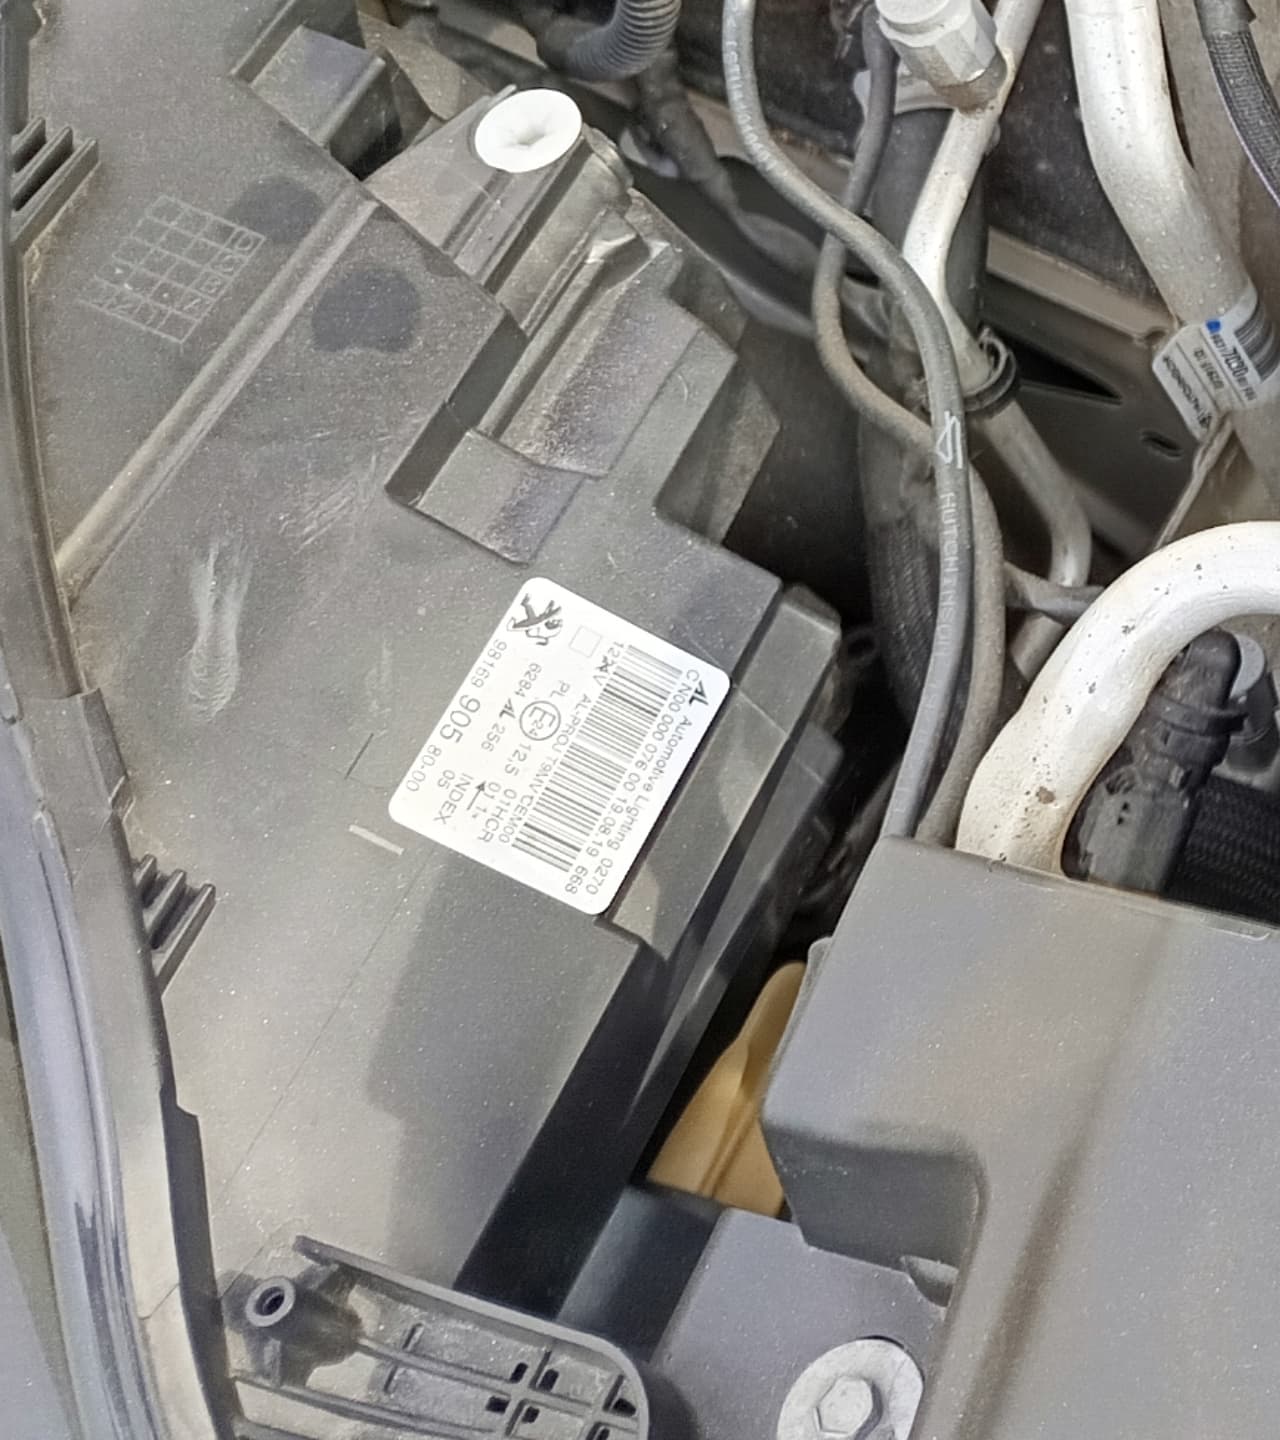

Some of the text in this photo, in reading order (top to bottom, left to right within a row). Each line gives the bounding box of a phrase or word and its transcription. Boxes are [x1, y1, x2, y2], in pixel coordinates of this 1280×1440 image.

[513, 660, 542, 699] 6284
[549, 678, 570, 702] PL
[404, 637, 508, 794] 98169 905 80-00
[550, 692, 593, 755] AL-PROJ
[650, 712, 674, 742] 000
[479, 721, 505, 753] 256
[634, 741, 658, 771] 076
[641, 714, 693, 794] Automotive
[433, 770, 474, 827] INDEX
[436, 767, 456, 790] 05
[621, 770, 641, 793] 00
[476, 785, 518, 845] 01HCR
[584, 795, 628, 858] 19.08.19
[606, 792, 649, 852] Lighting
[583, 855, 614, 896] 0270
